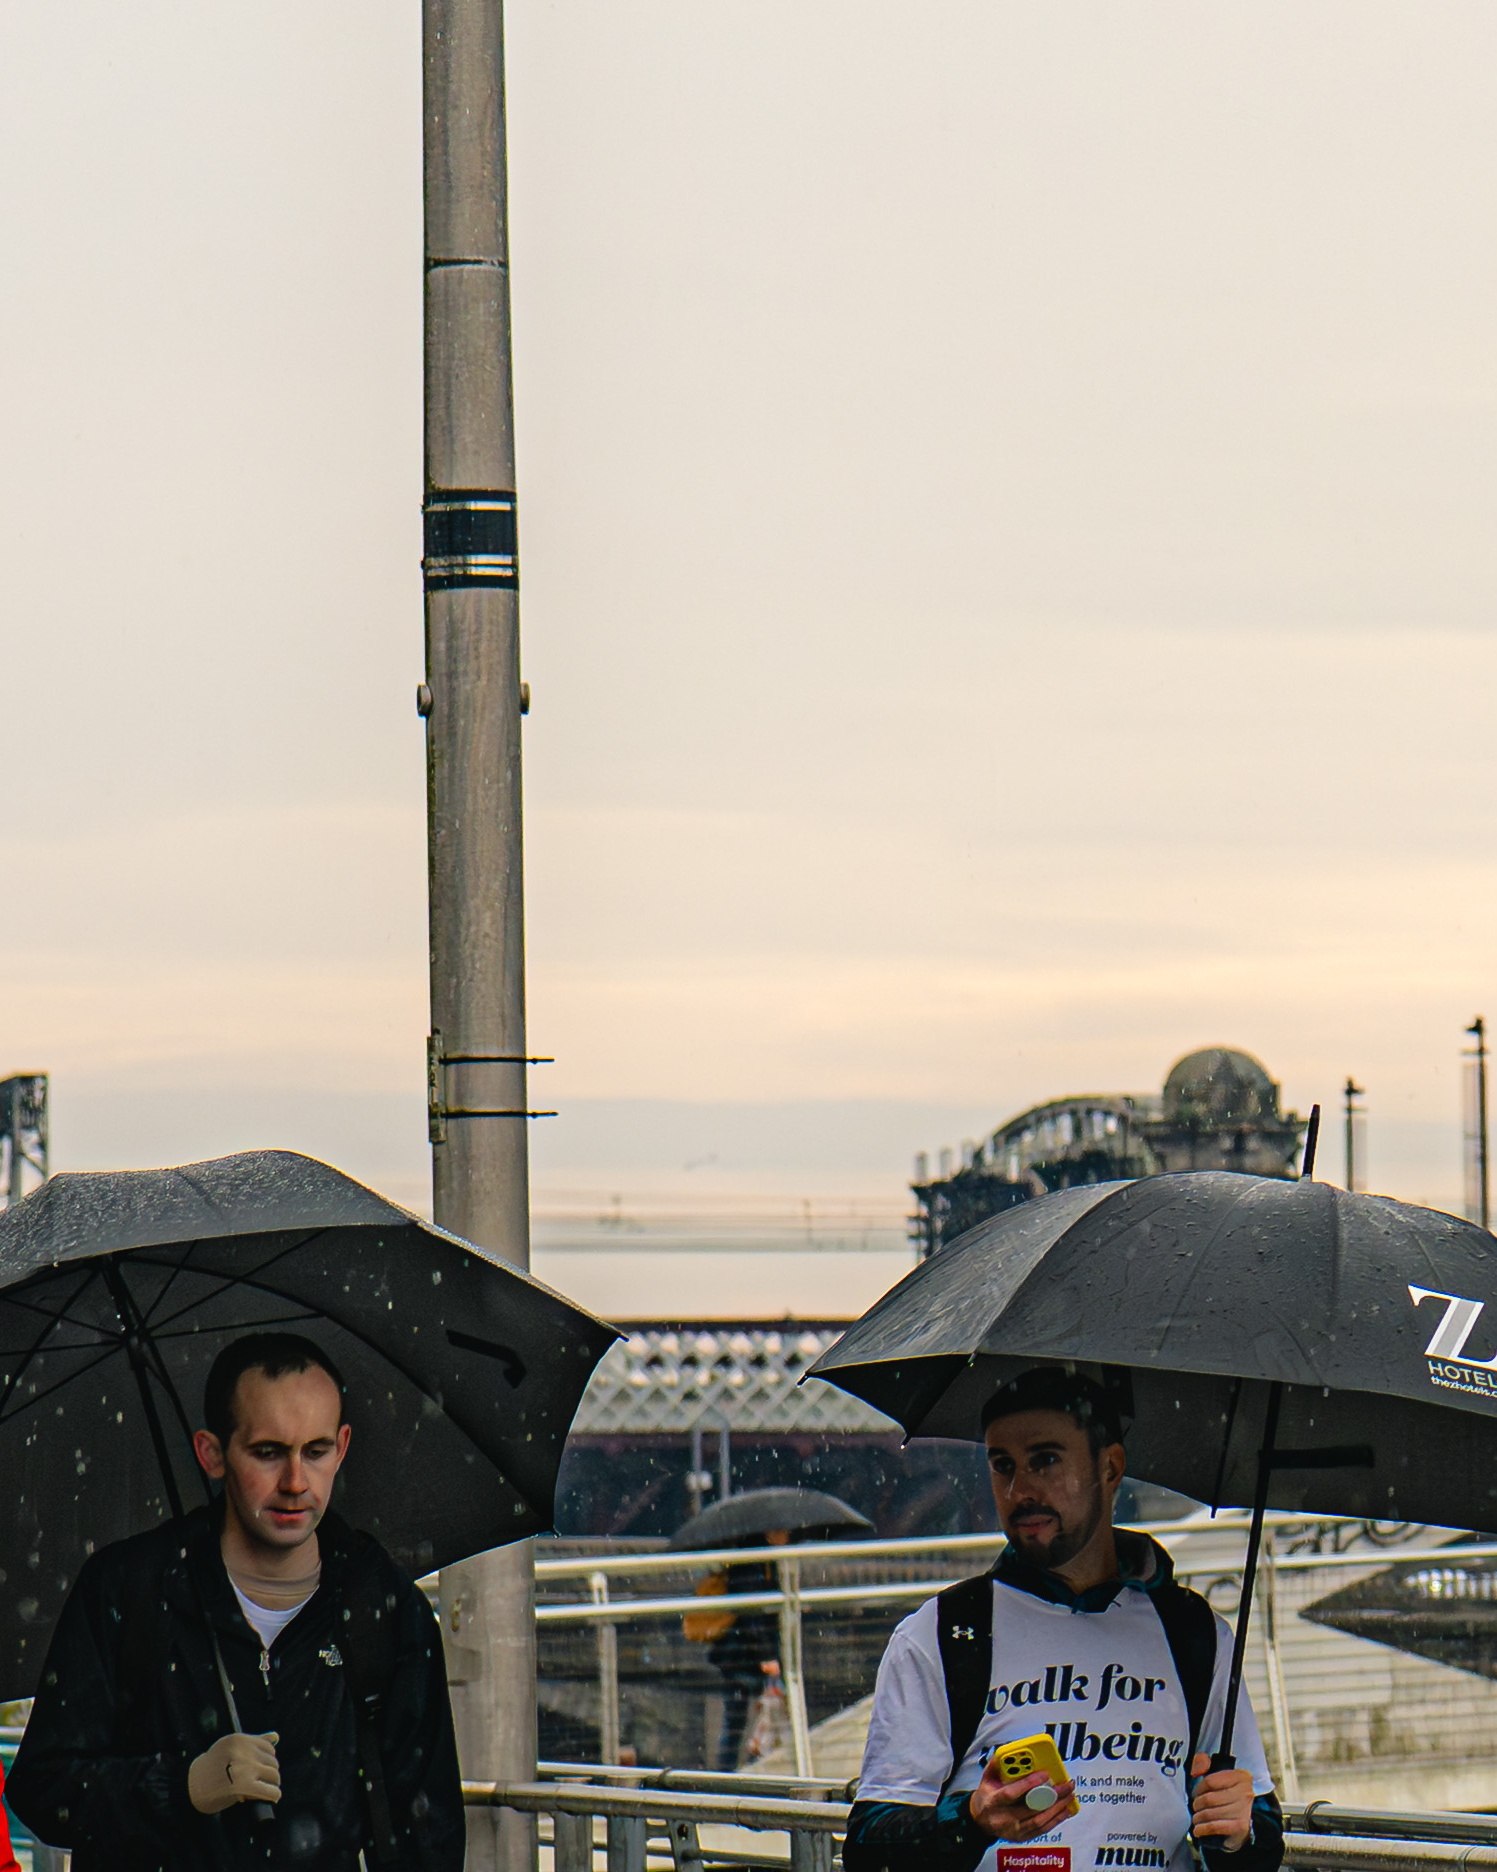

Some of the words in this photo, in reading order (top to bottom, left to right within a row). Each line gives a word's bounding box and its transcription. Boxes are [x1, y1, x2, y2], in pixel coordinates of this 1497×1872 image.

[1095, 1663, 1167, 1711] for
[978, 1721, 1184, 1777] lbeing
[1090, 1775, 1113, 1787] and
[1115, 1775, 1145, 1788] make
[1099, 1791, 1147, 1805] together
[1050, 1832, 1062, 1842] of
[1107, 1832, 1146, 1843] powered
[1147, 1832, 1158, 1845] by
[1003, 1855, 1065, 1869] Hospitality
